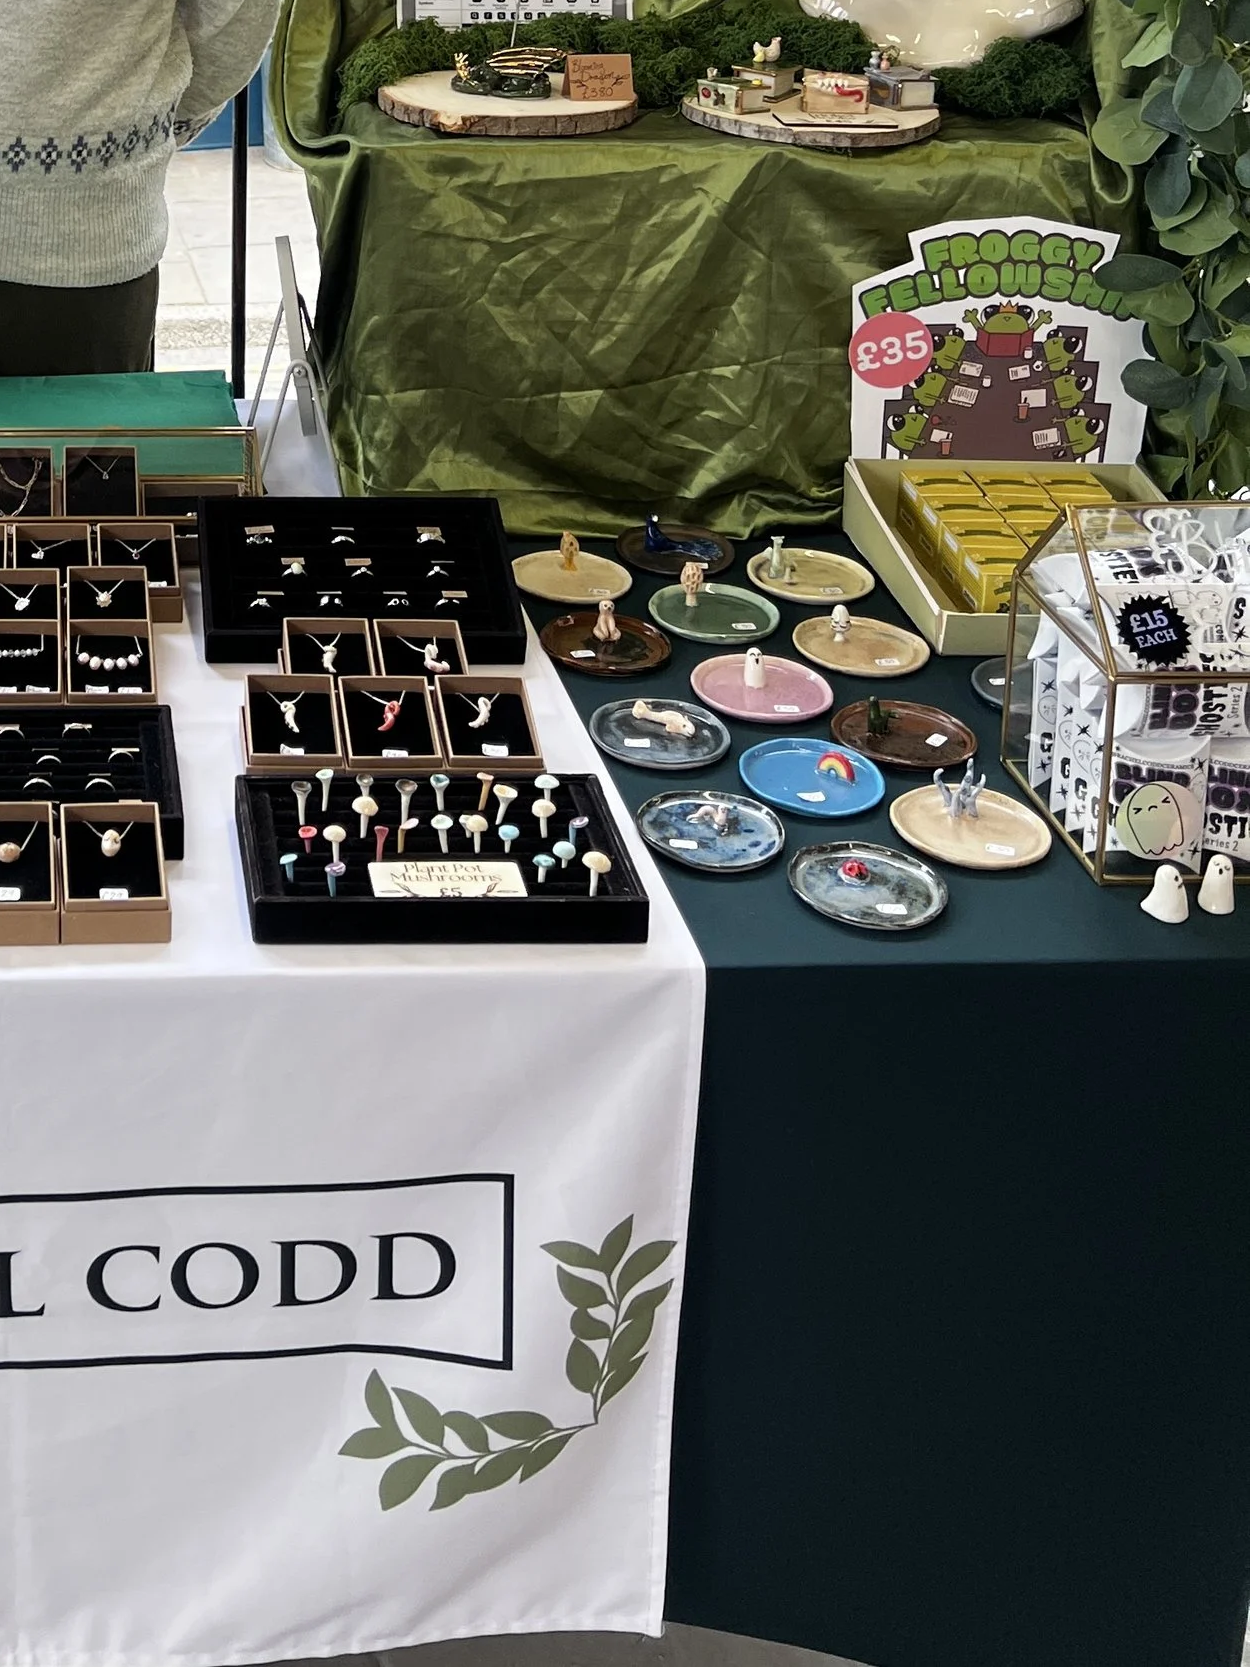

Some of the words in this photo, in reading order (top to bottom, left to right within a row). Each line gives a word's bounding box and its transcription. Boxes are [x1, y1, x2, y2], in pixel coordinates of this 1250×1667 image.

[922, 230, 1105, 272] FROGGY
[856, 330, 929, 372] £35
[1129, 609, 1169, 634] £15
[1135, 628, 1178, 649] EACH
[1204, 837, 1230, 849] eries
[390, 872, 503, 883] Mushrooms
[403, 862, 449, 873] Plant
[453, 863, 484, 873] Pot
[440, 887, 463, 897] £5
[86, 1231, 458, 1313] CODD
